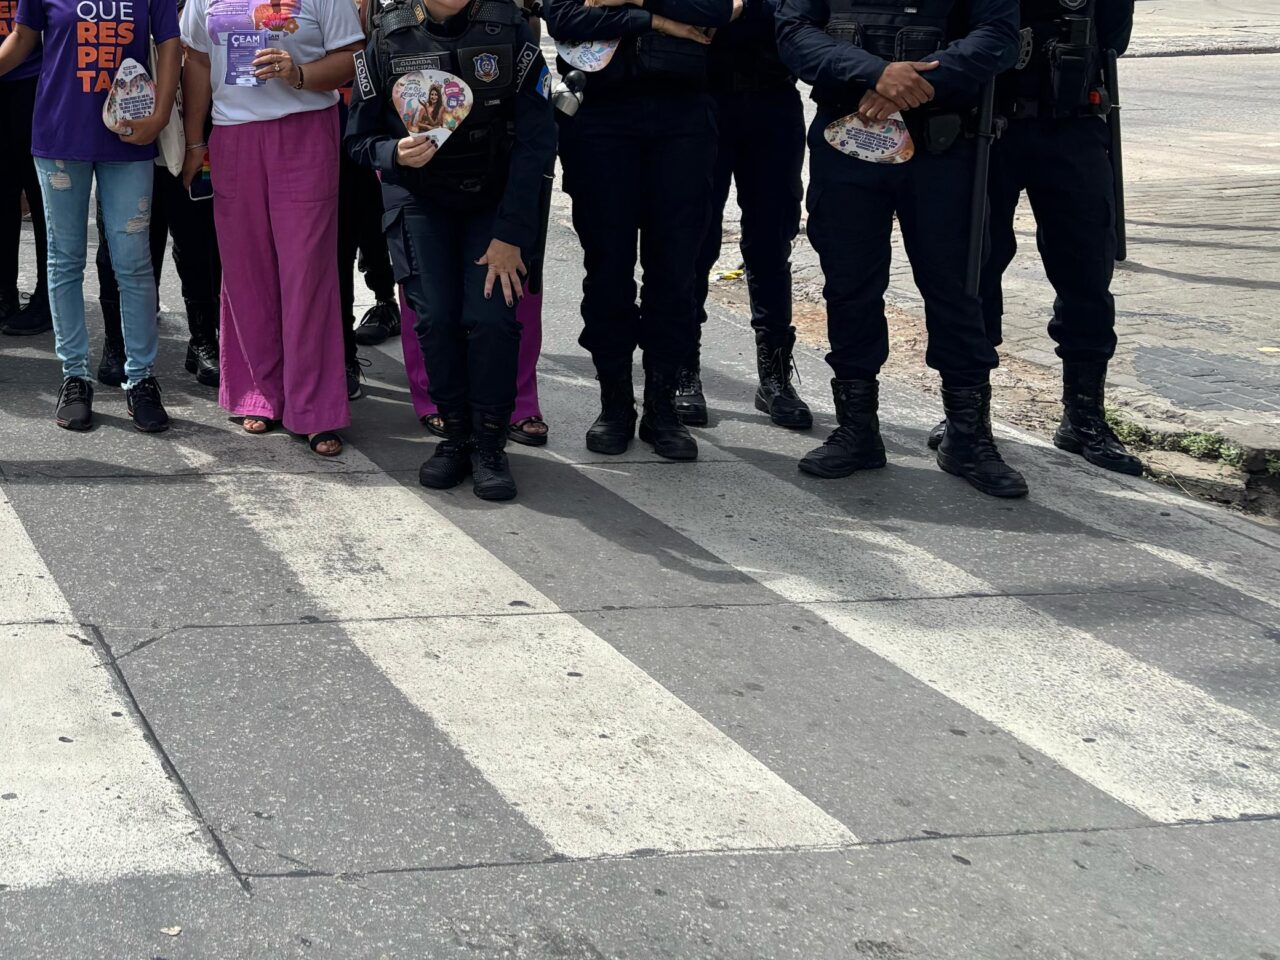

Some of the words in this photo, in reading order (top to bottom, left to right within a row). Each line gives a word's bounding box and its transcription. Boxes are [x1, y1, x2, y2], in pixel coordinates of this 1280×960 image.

[77, 1, 134, 22] QUE
[77, 22, 135, 44] RES
[231, 34, 260, 46] CEAM
[78, 46, 123, 68] PEI
[396, 64, 438, 72] MUNICIPAL
[77, 70, 113, 92] TA
[356, 58, 371, 92] GCMO
